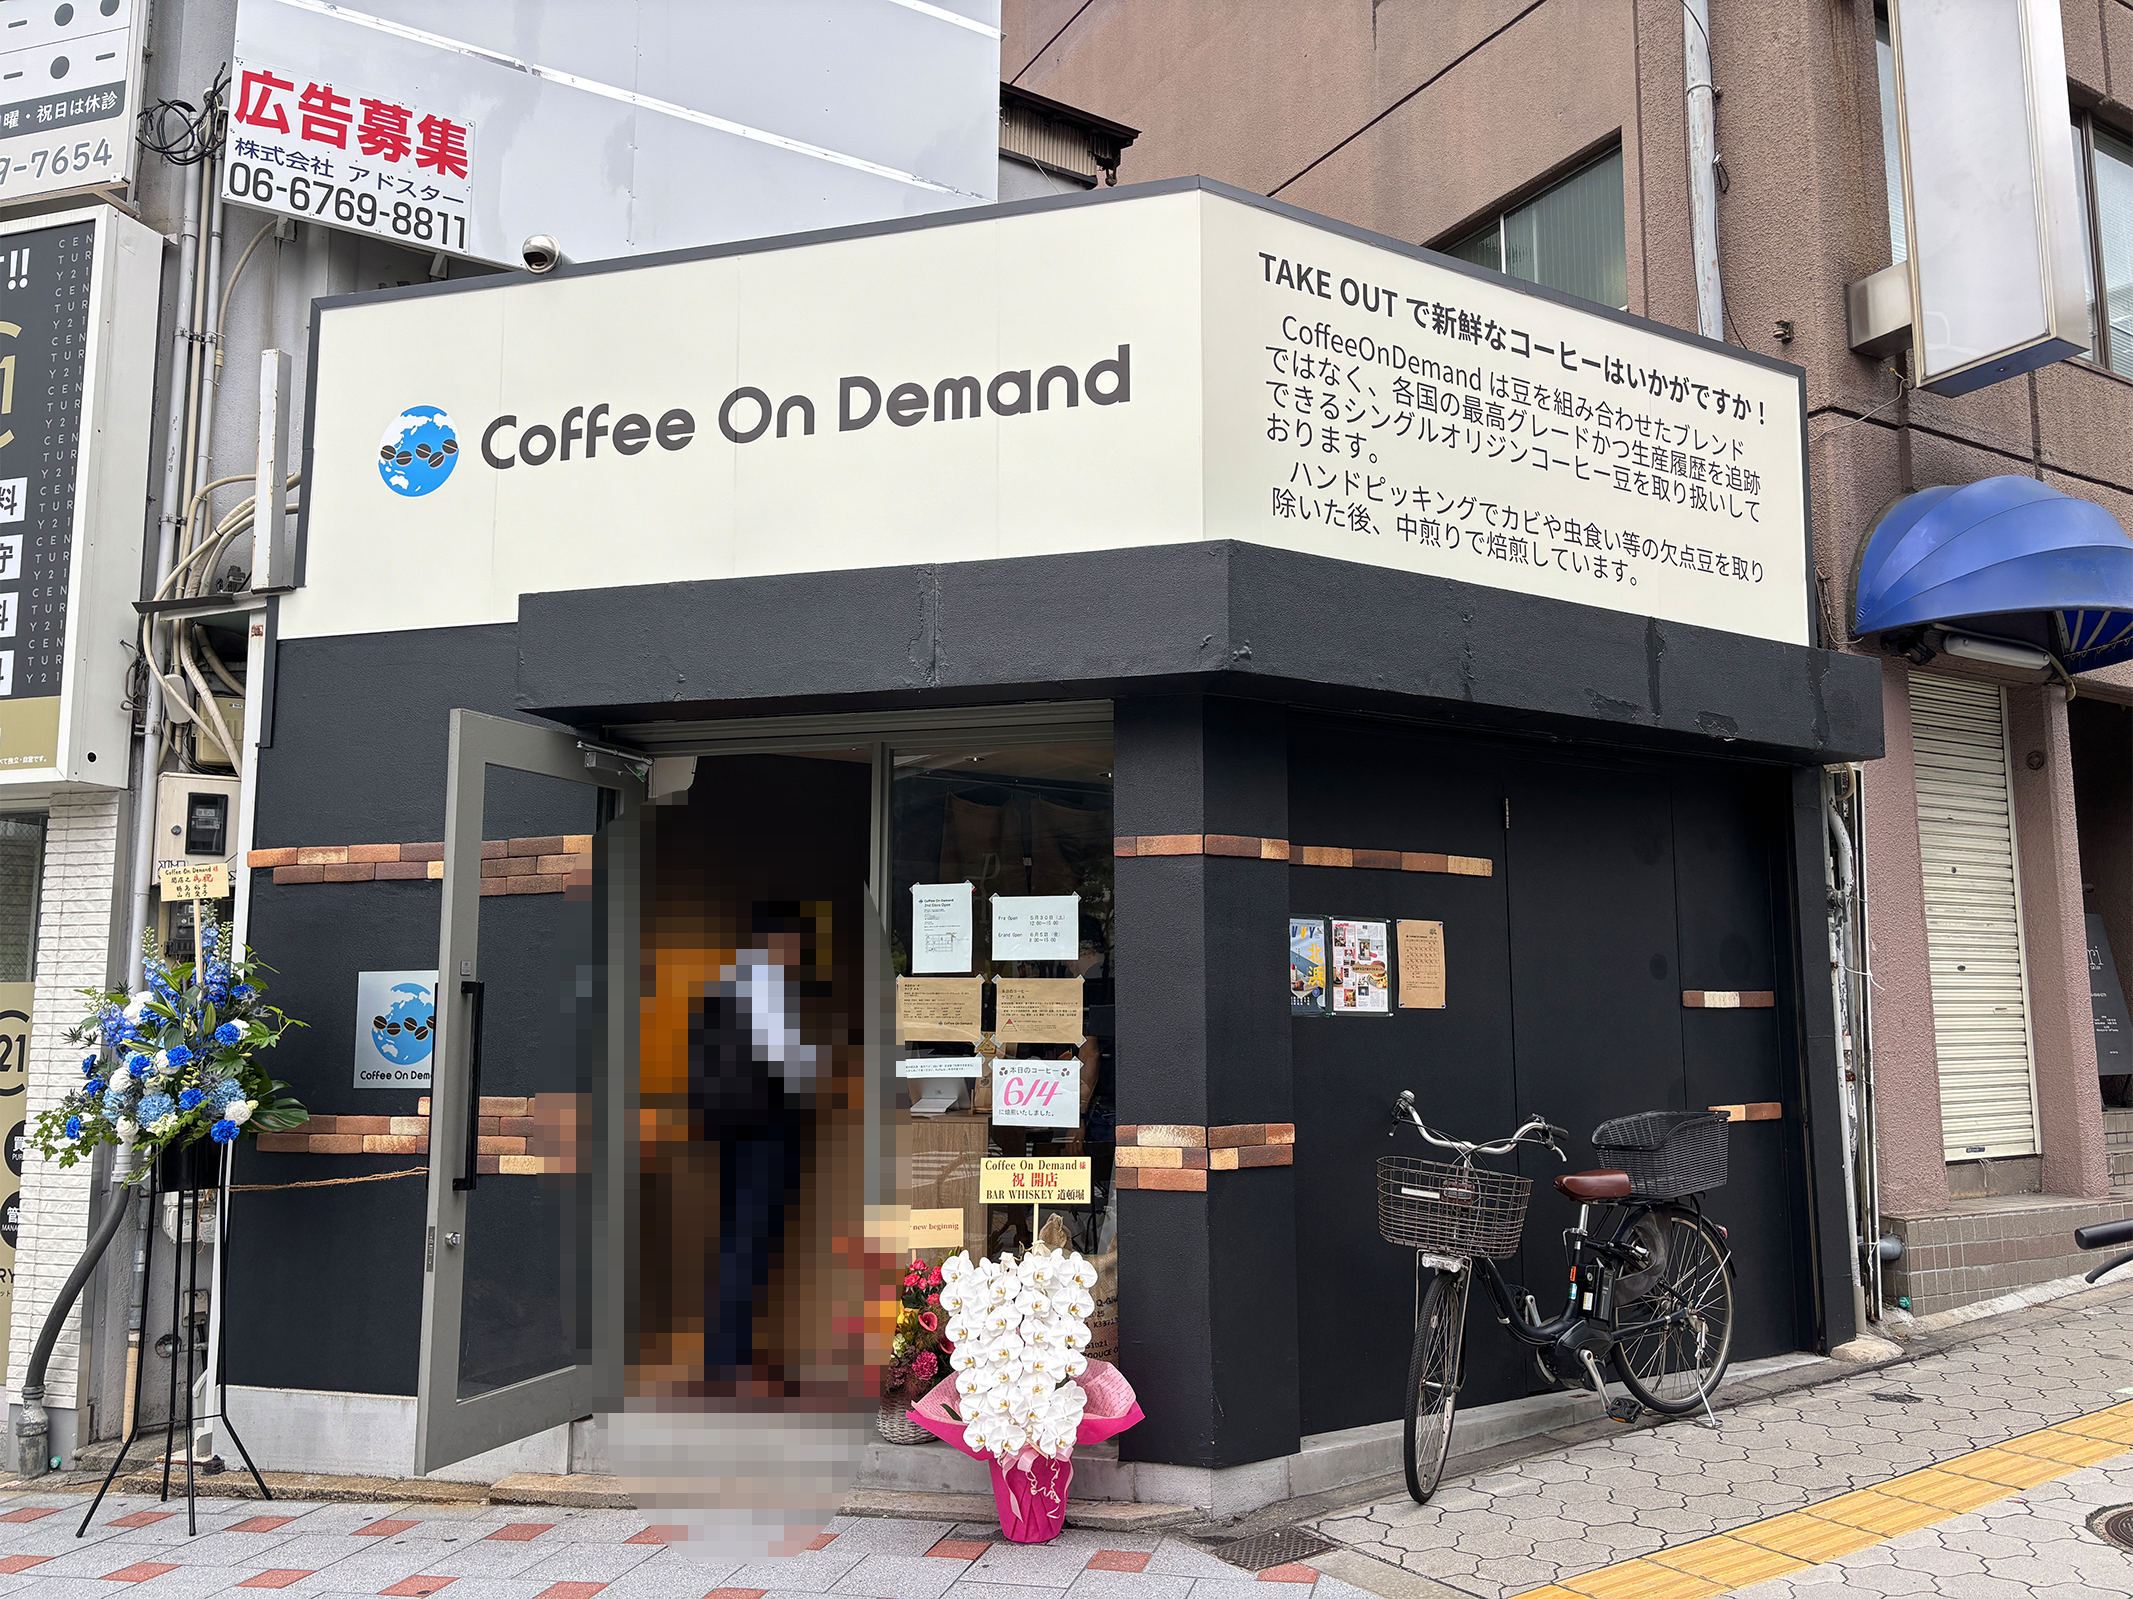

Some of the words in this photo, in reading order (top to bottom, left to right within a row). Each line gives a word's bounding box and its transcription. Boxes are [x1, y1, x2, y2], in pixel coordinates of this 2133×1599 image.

[0, 91, 118, 130] 曜・祝日は休診
[234, 70, 468, 180] 広告募集
[229, 162, 465, 249] 06-6769-8811
[234, 137, 334, 178] 株式会社
[348, 165, 464, 204] アドスター
[1258, 251, 1332, 300] TAKE
[1340, 277, 1398, 317] OUT
[1406, 298, 1765, 425] で新鮮なコーヒーはいかがですか！
[481, 403, 696, 470] Coffee
[718, 386, 815, 444] On
[838, 344, 1131, 433] Demand
[1265, 346, 1762, 496] ではなく、各国の最高グレードかつ生産履歴を追跡
[1281, 315, 1482, 392] CoffeeOnDemand
[1491, 371, 1744, 462] は豆を組み合わせたブレンド
[1265, 380, 1760, 523] できるシングルオリジンコーヒー豆を取り扱いして
[1266, 412, 1378, 464] おります。
[1272, 487, 1638, 586] 除いた後、中煎りで焙煎しています。
[1290, 461, 1764, 583] ハンドピッキングでカビや虫食い等の欠点豆を取り
[360, 1070, 392, 1080] Coffee
[394, 1070, 409, 1080] On
[411, 1070, 432, 1080] Dem
[1004, 1077, 1063, 1107] 6/4
[1009, 1066, 1060, 1075] 本日のコーヒー
[985, 1160, 1016, 1170] Coffee
[1020, 1160, 1034, 1170] On
[1038, 1159, 1077, 1170] Demand
[986, 1189, 1005, 1199] BAR
[1008, 1189, 1054, 1199] WHISKEY
[1012, 1172, 1025, 1187] 祝
[1031, 1172, 1058, 1187] 開店
